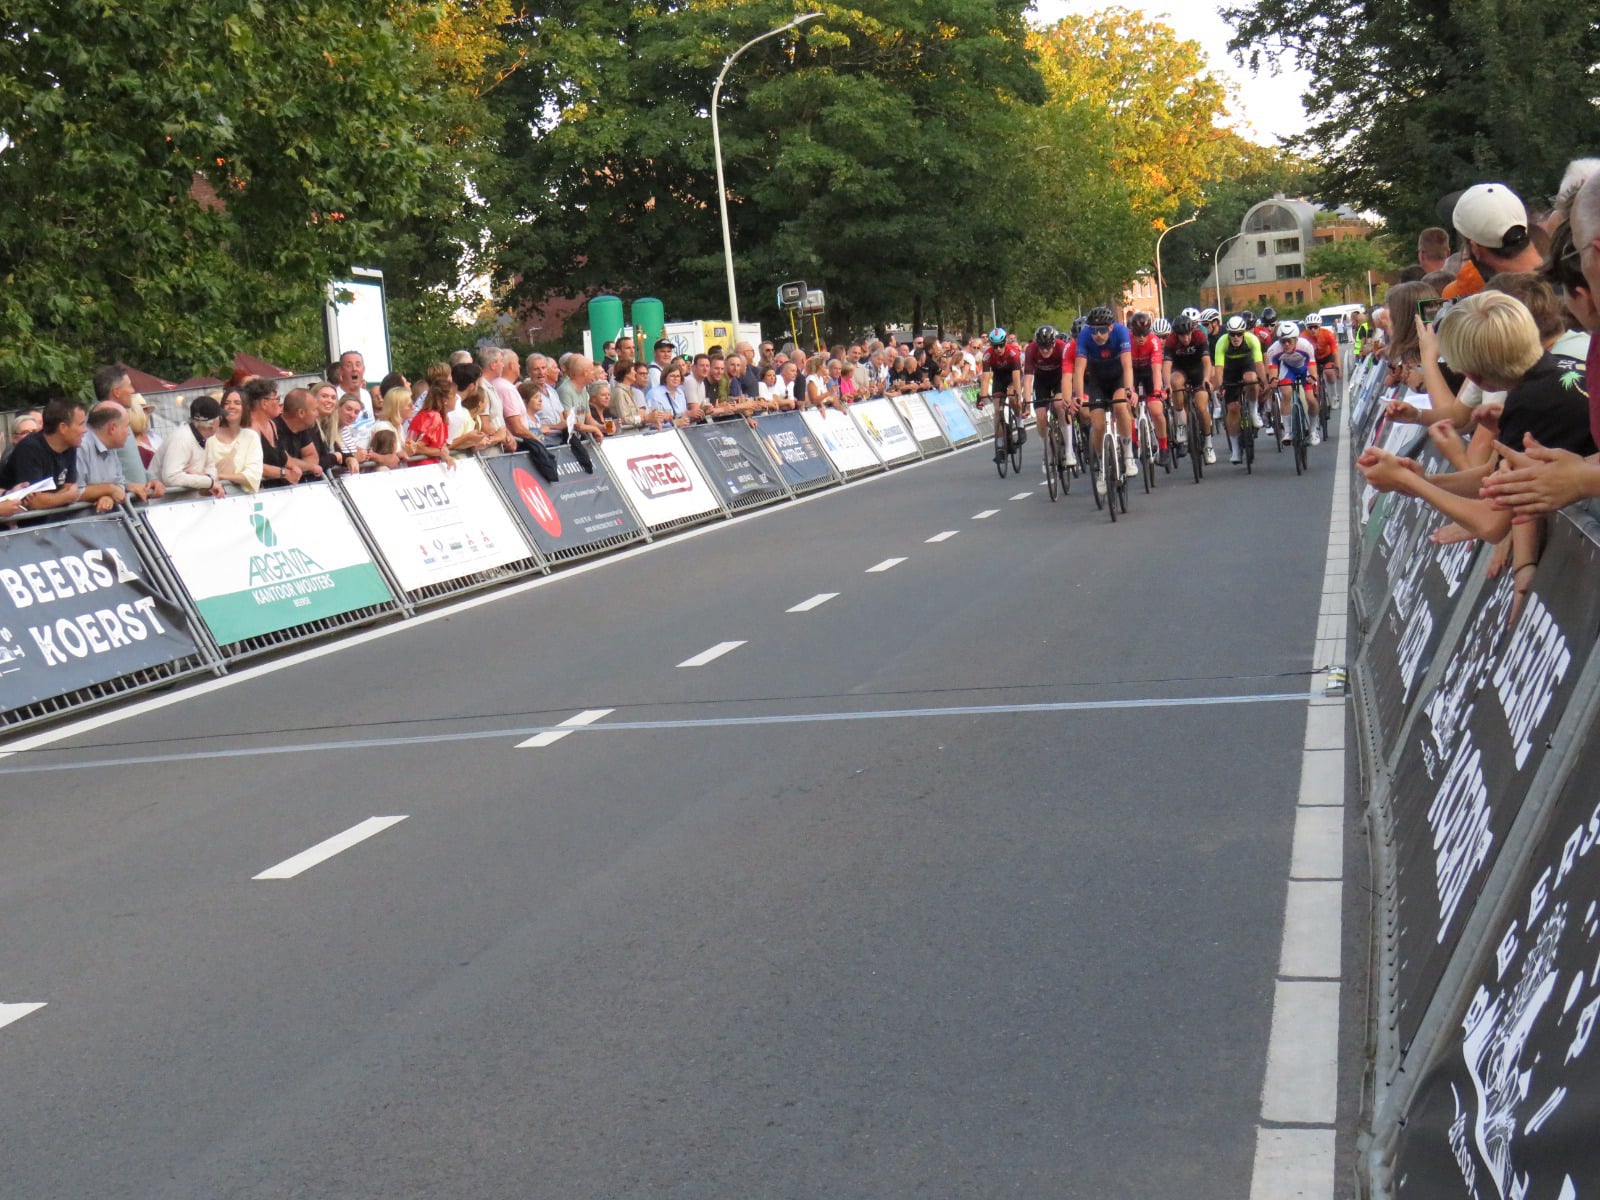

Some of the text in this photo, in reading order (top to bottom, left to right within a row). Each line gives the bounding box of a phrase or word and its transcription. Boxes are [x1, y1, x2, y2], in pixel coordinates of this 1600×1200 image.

[631, 460, 688, 491] WIRECO
[395, 481, 450, 513] HUYBS
[521, 486, 554, 523] W
[248, 547, 325, 587] ARGENTA
[252, 583, 298, 606] KANTOOR
[29, 595, 167, 667] KOERST
[1492, 591, 1571, 772] BEERSE
[1427, 728, 1494, 945] KOERST
[1462, 801, 1600, 1040] BEERS
